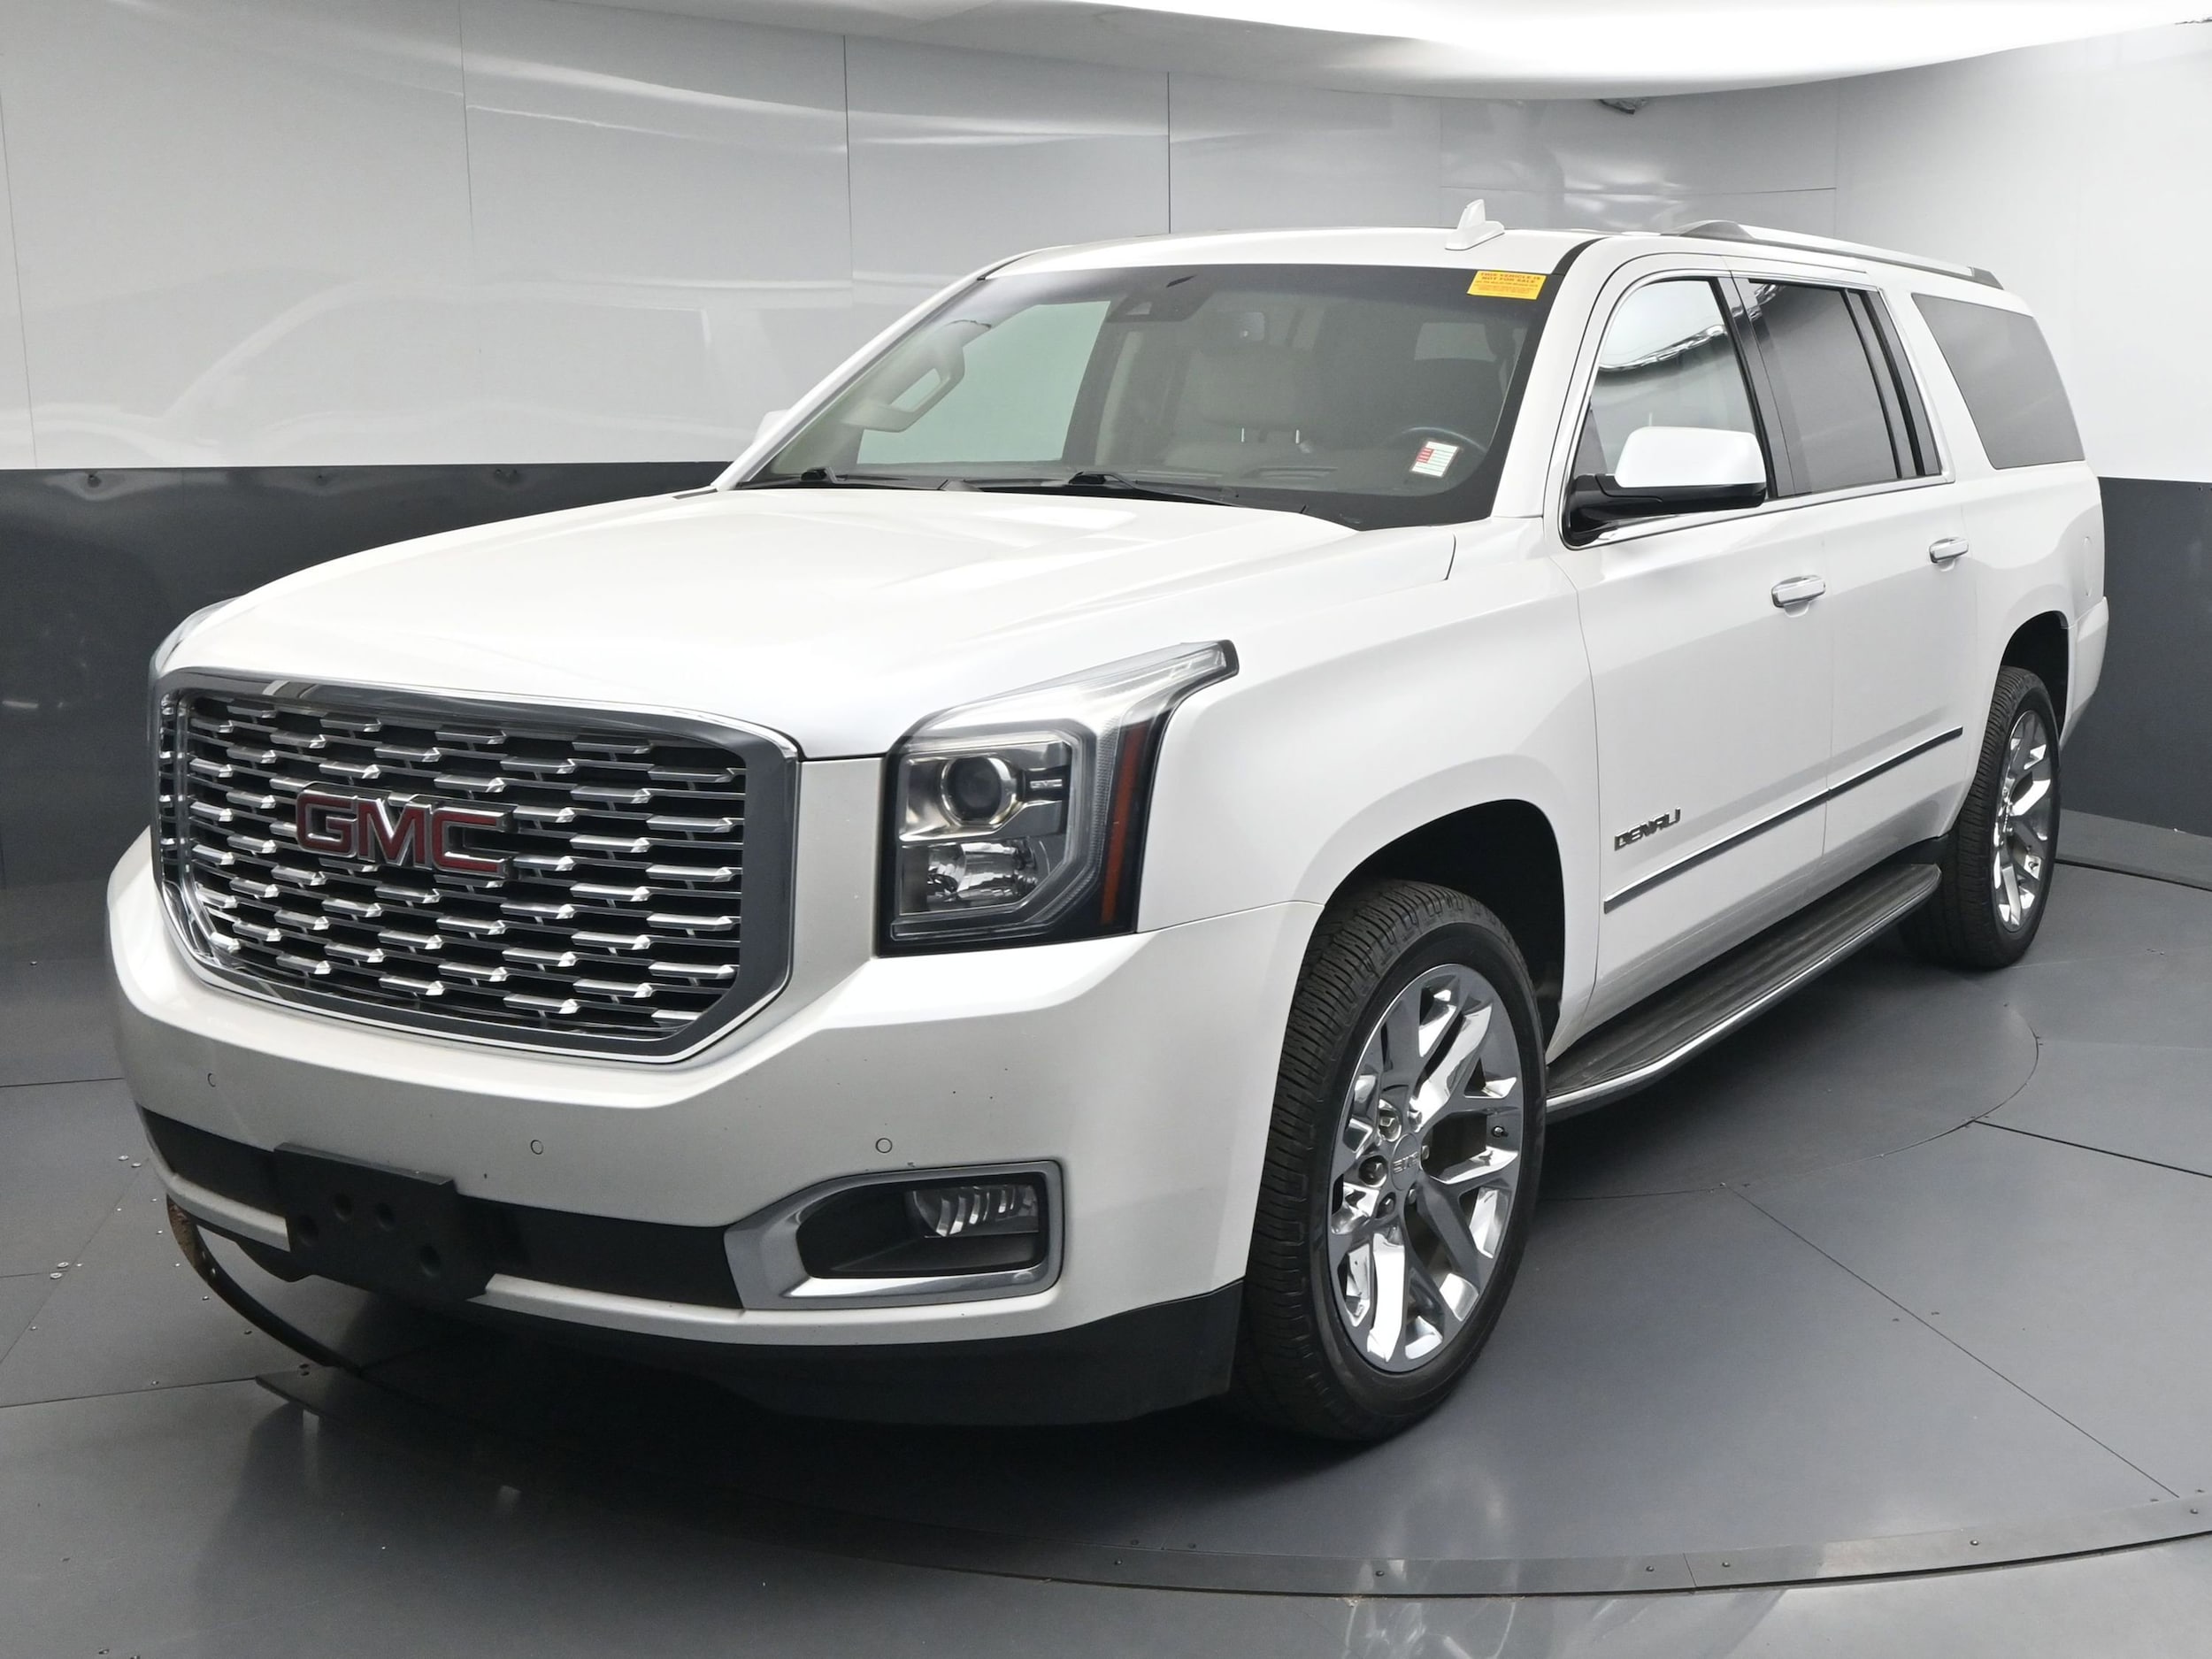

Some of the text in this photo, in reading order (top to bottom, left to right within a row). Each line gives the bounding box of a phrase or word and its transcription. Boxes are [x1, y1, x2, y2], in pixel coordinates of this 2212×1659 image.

[1029, 779, 1063, 788] GMC
[296, 788, 507, 879] GMC
[1614, 807, 1681, 851] DENALI
